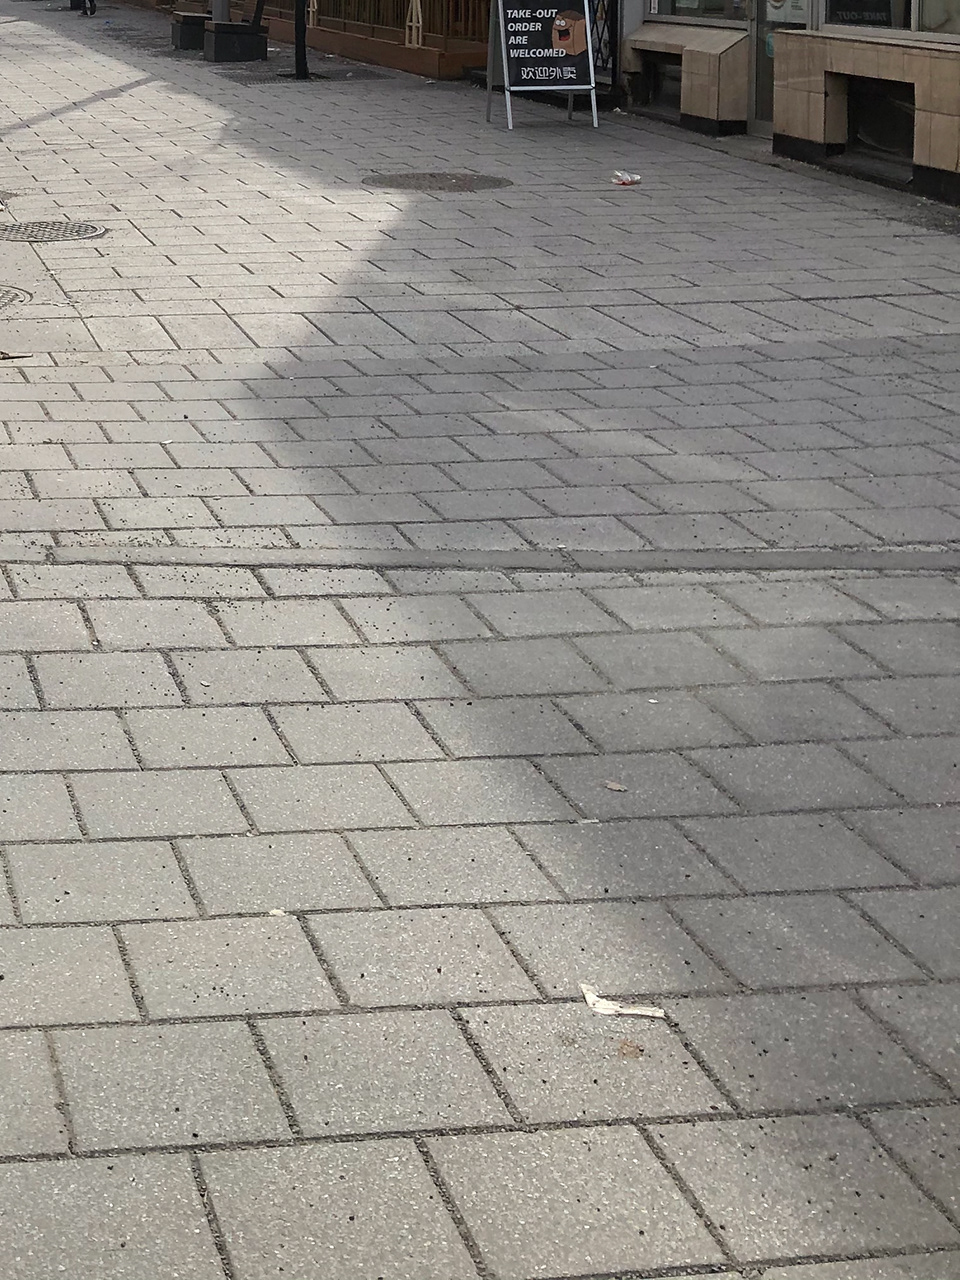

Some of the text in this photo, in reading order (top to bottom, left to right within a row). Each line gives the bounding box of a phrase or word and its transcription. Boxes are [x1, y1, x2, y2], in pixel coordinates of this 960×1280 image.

[507, 22, 542, 32] ORDER
[508, 36, 528, 45] ARE
[510, 48, 566, 58] WELCOMED
[521, 66, 577, 81] 欢迎外卖
